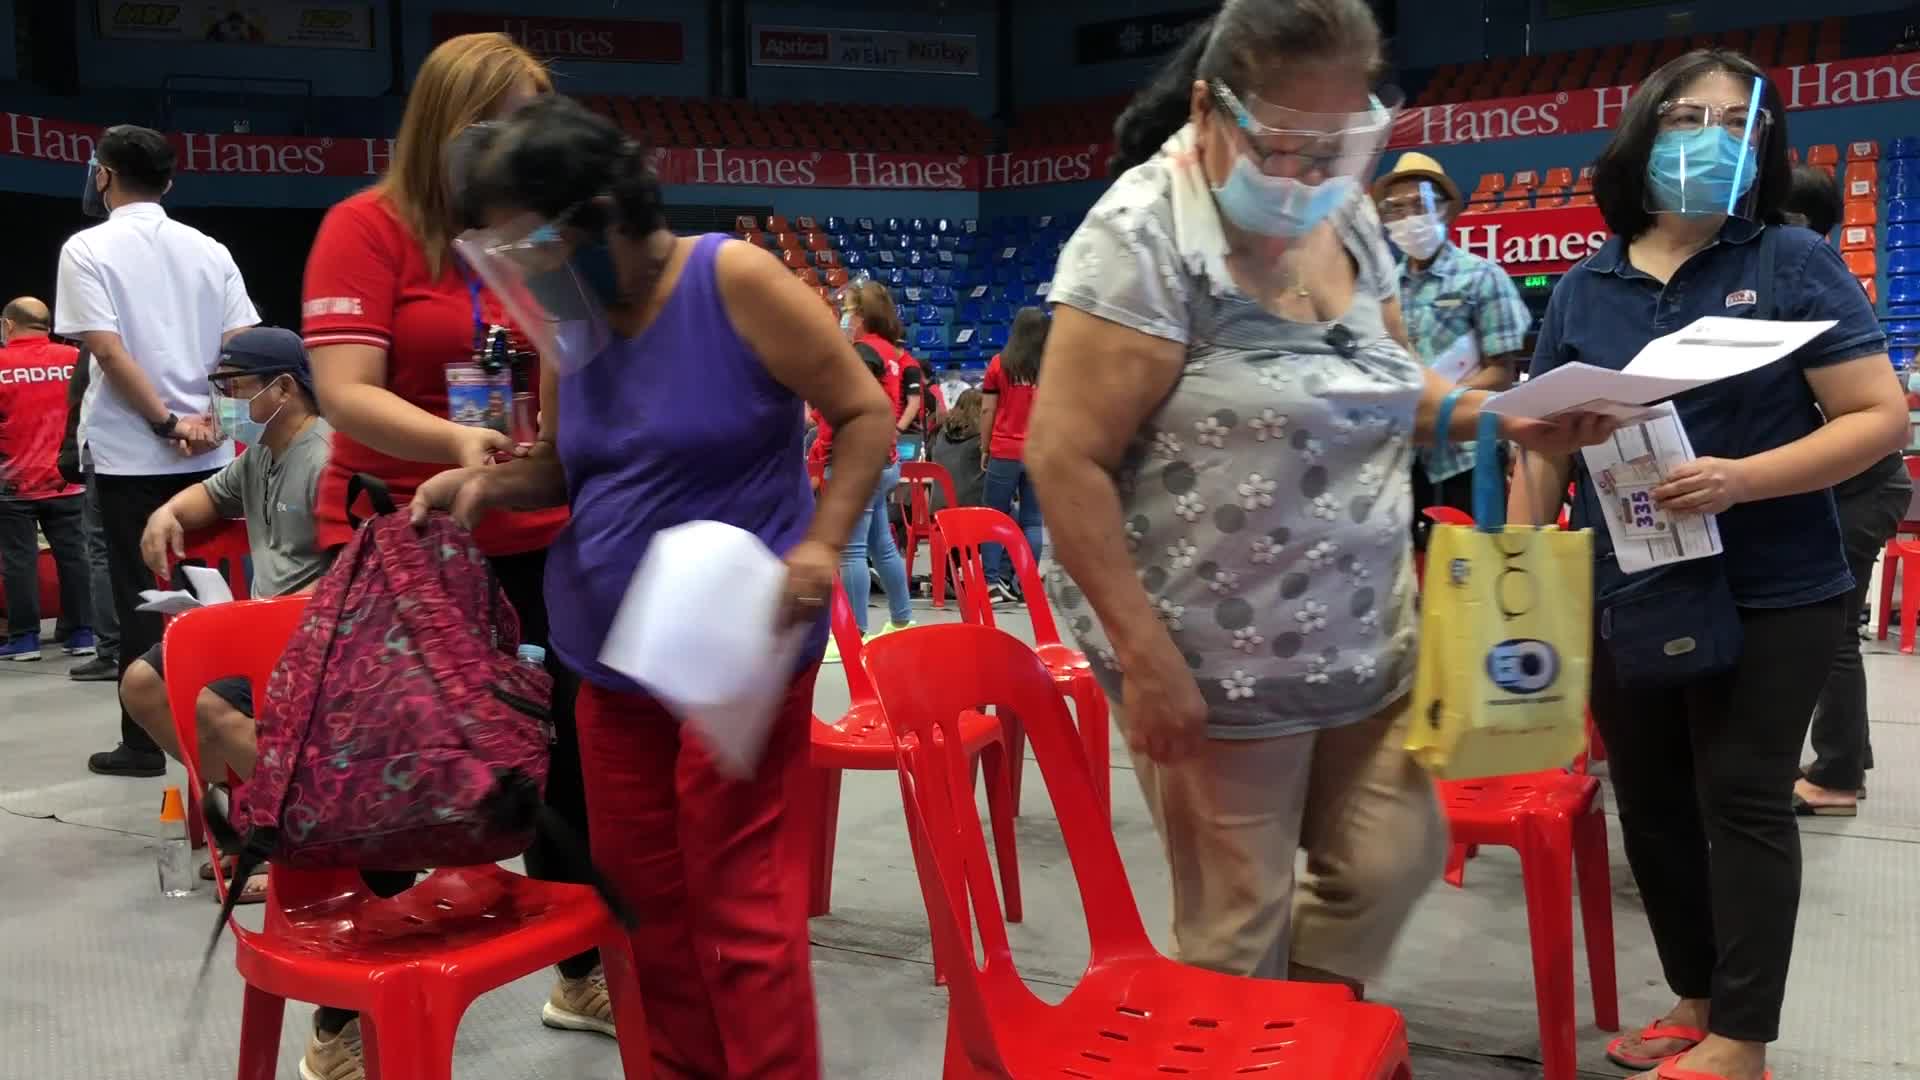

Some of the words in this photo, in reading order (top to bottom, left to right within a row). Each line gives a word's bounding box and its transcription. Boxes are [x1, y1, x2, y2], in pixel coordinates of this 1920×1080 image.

[1785, 63, 1920, 109] Hane
[6, 112, 97, 163] Han
[1525, 276, 1547, 287] EXIT
[1631, 491, 1654, 528] 335
